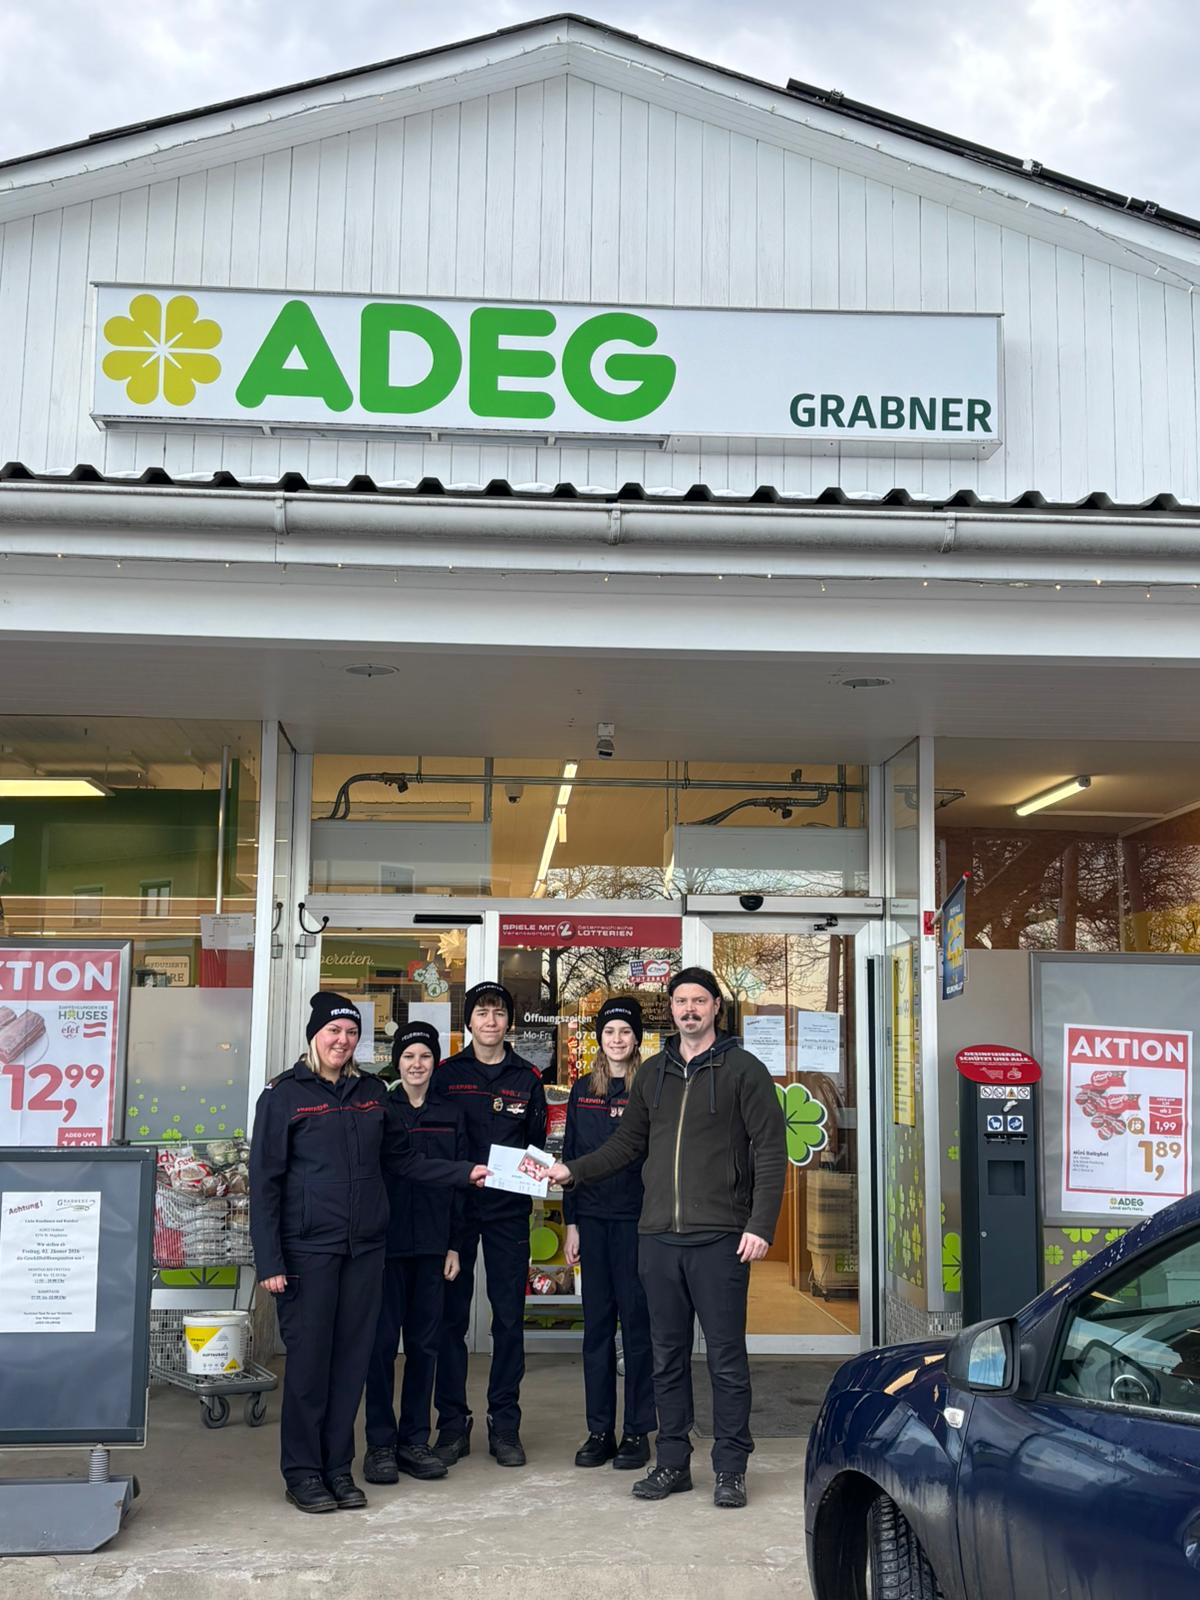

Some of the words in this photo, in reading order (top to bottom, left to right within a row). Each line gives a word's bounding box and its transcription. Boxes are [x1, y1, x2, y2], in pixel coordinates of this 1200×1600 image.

[235, 299, 677, 422] ADEG
[790, 393, 992, 433] GRABNER
[58, 1011, 108, 1020] HAUSES
[524, 1011, 592, 1024] Öffnungszeiten
[1072, 1036, 1184, 1063] AKTION
[1155, 1121, 1177, 1132] 1,99
[9, 1202, 39, 1214] Achtung
[1117, 1198, 1144, 1207] ADEG
